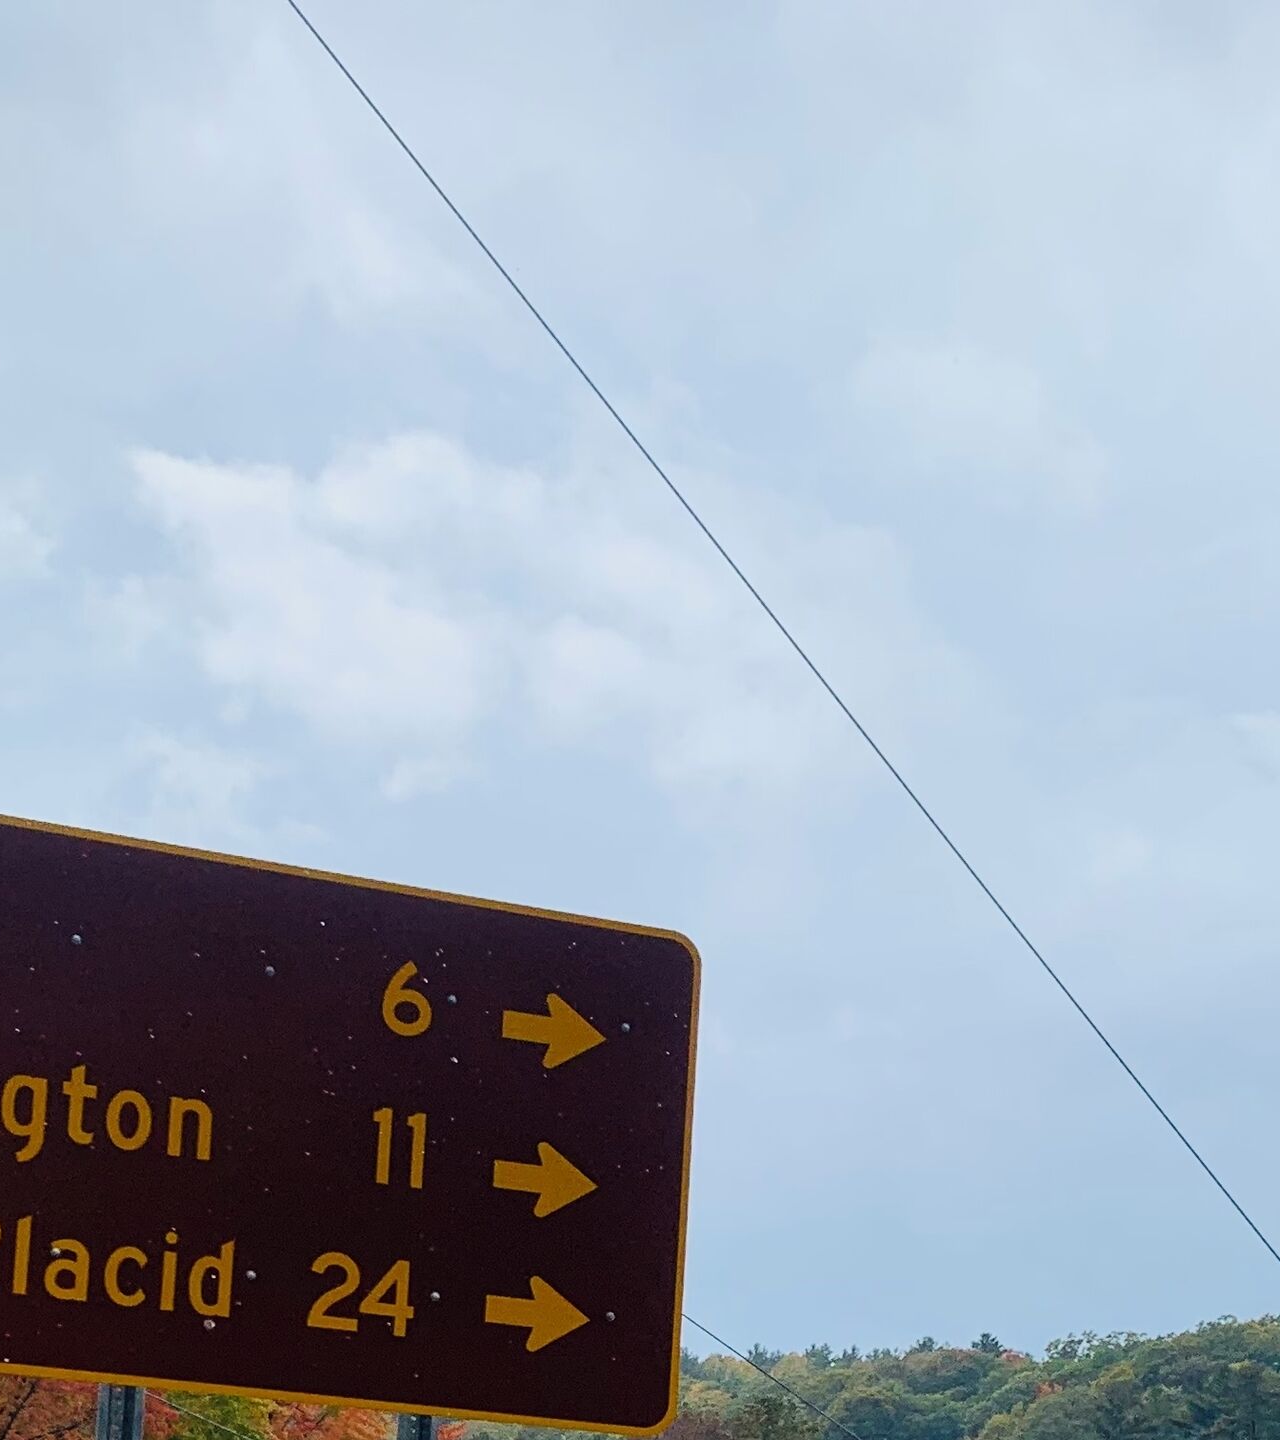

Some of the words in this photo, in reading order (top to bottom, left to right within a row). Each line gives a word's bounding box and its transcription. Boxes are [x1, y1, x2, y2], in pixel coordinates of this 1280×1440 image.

[382, 961, 433, 1037] 6
[373, 1107, 428, 1189] 11
[307, 1251, 415, 1337] 24
